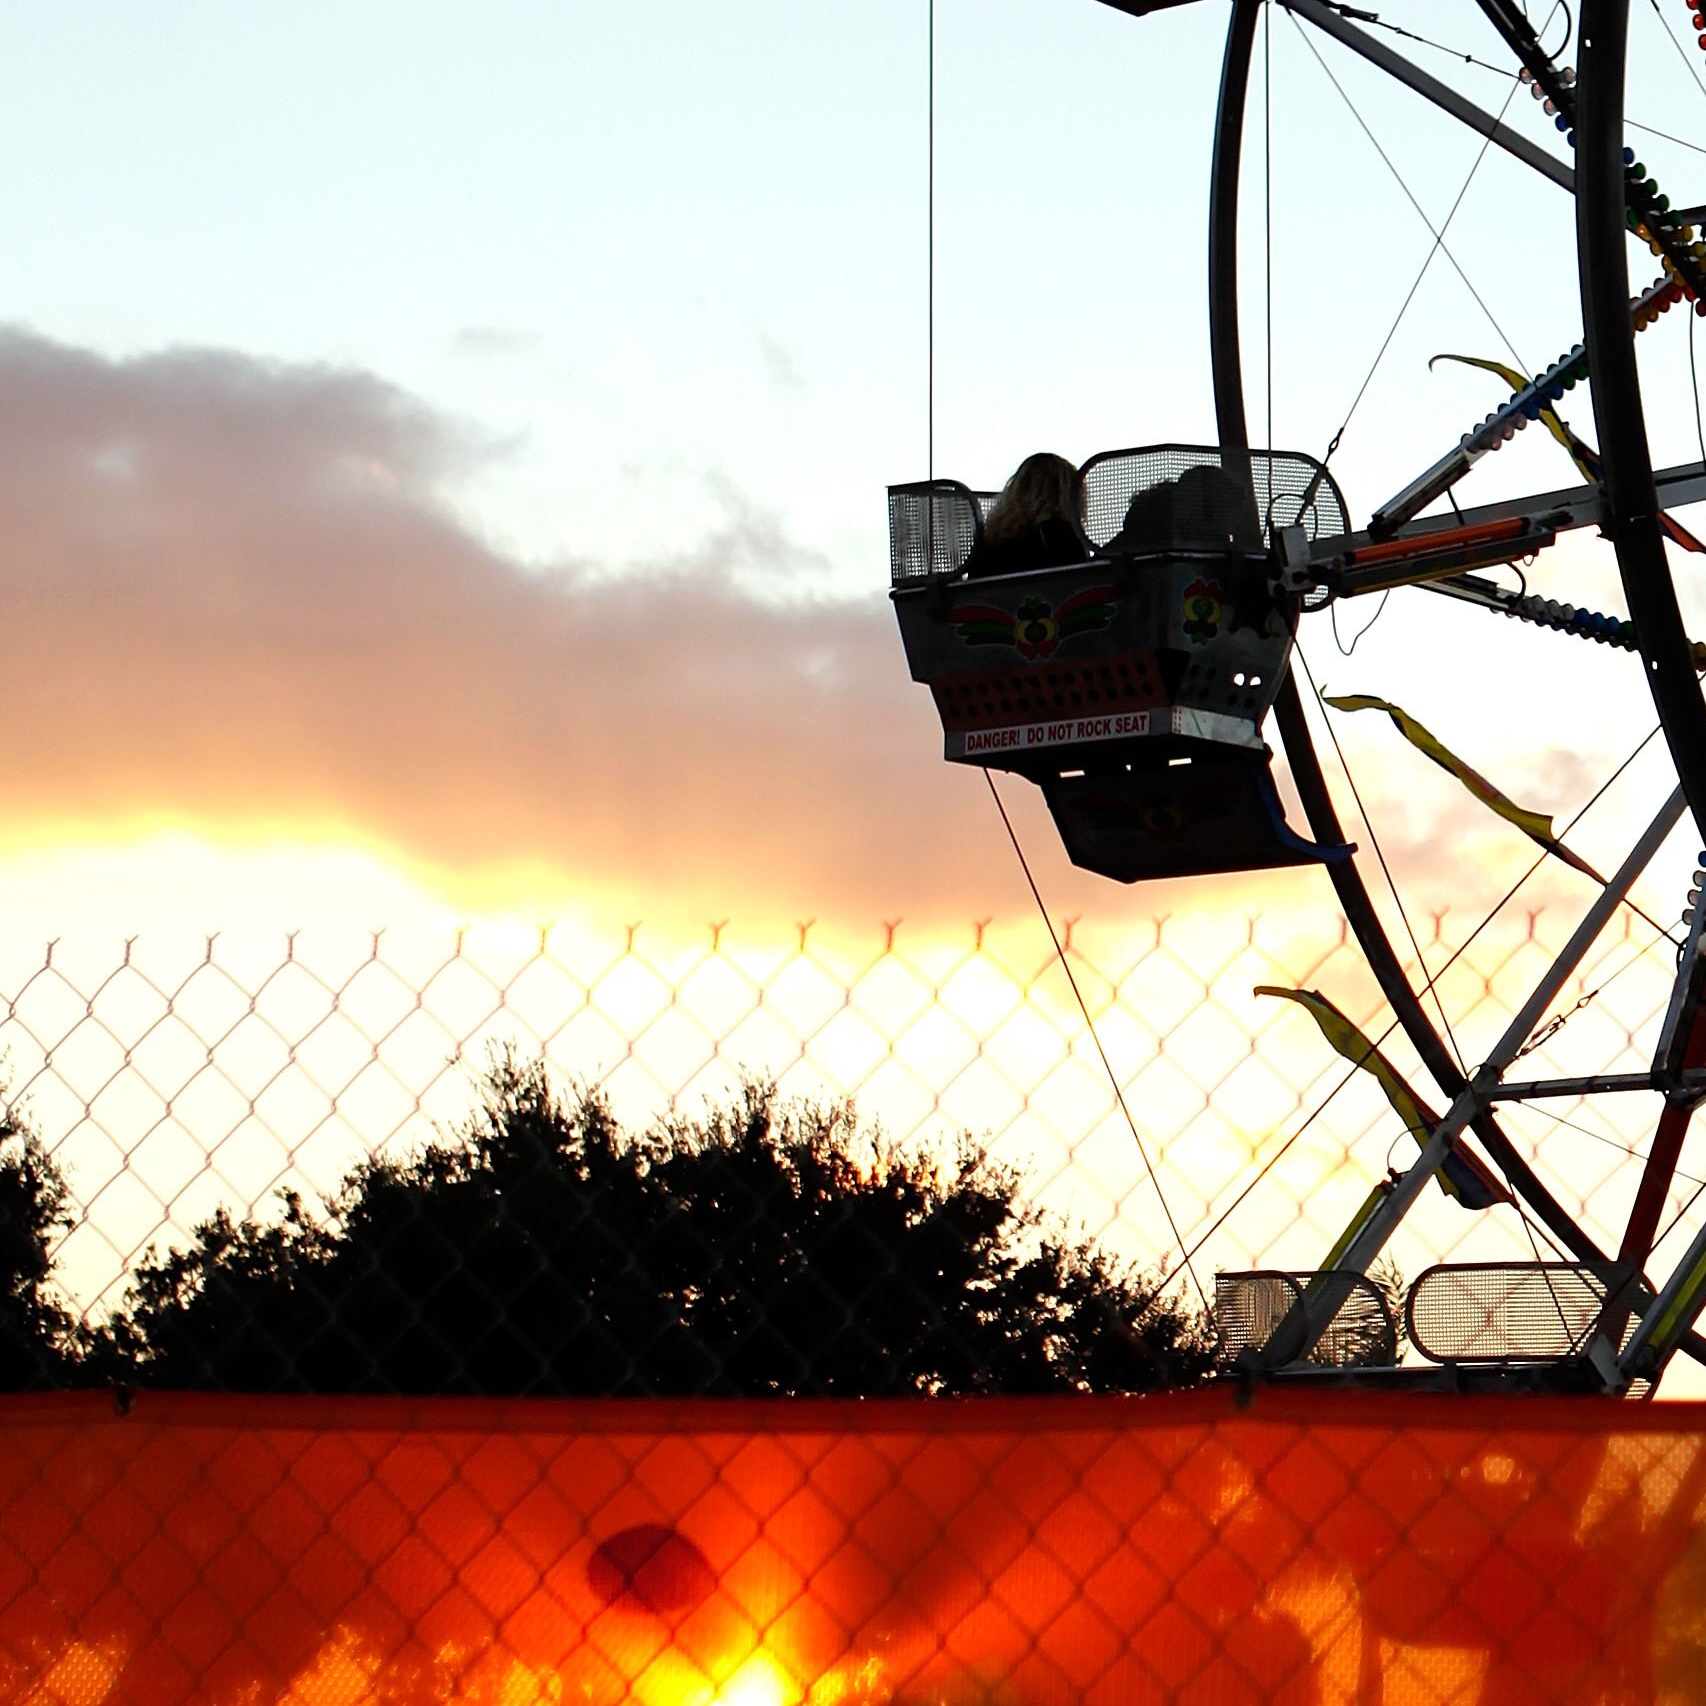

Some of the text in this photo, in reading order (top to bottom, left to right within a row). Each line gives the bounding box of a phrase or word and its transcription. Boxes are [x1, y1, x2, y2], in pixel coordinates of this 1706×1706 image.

[967, 715, 1147, 751] DANGER! DO NOT ROCK SEAT
